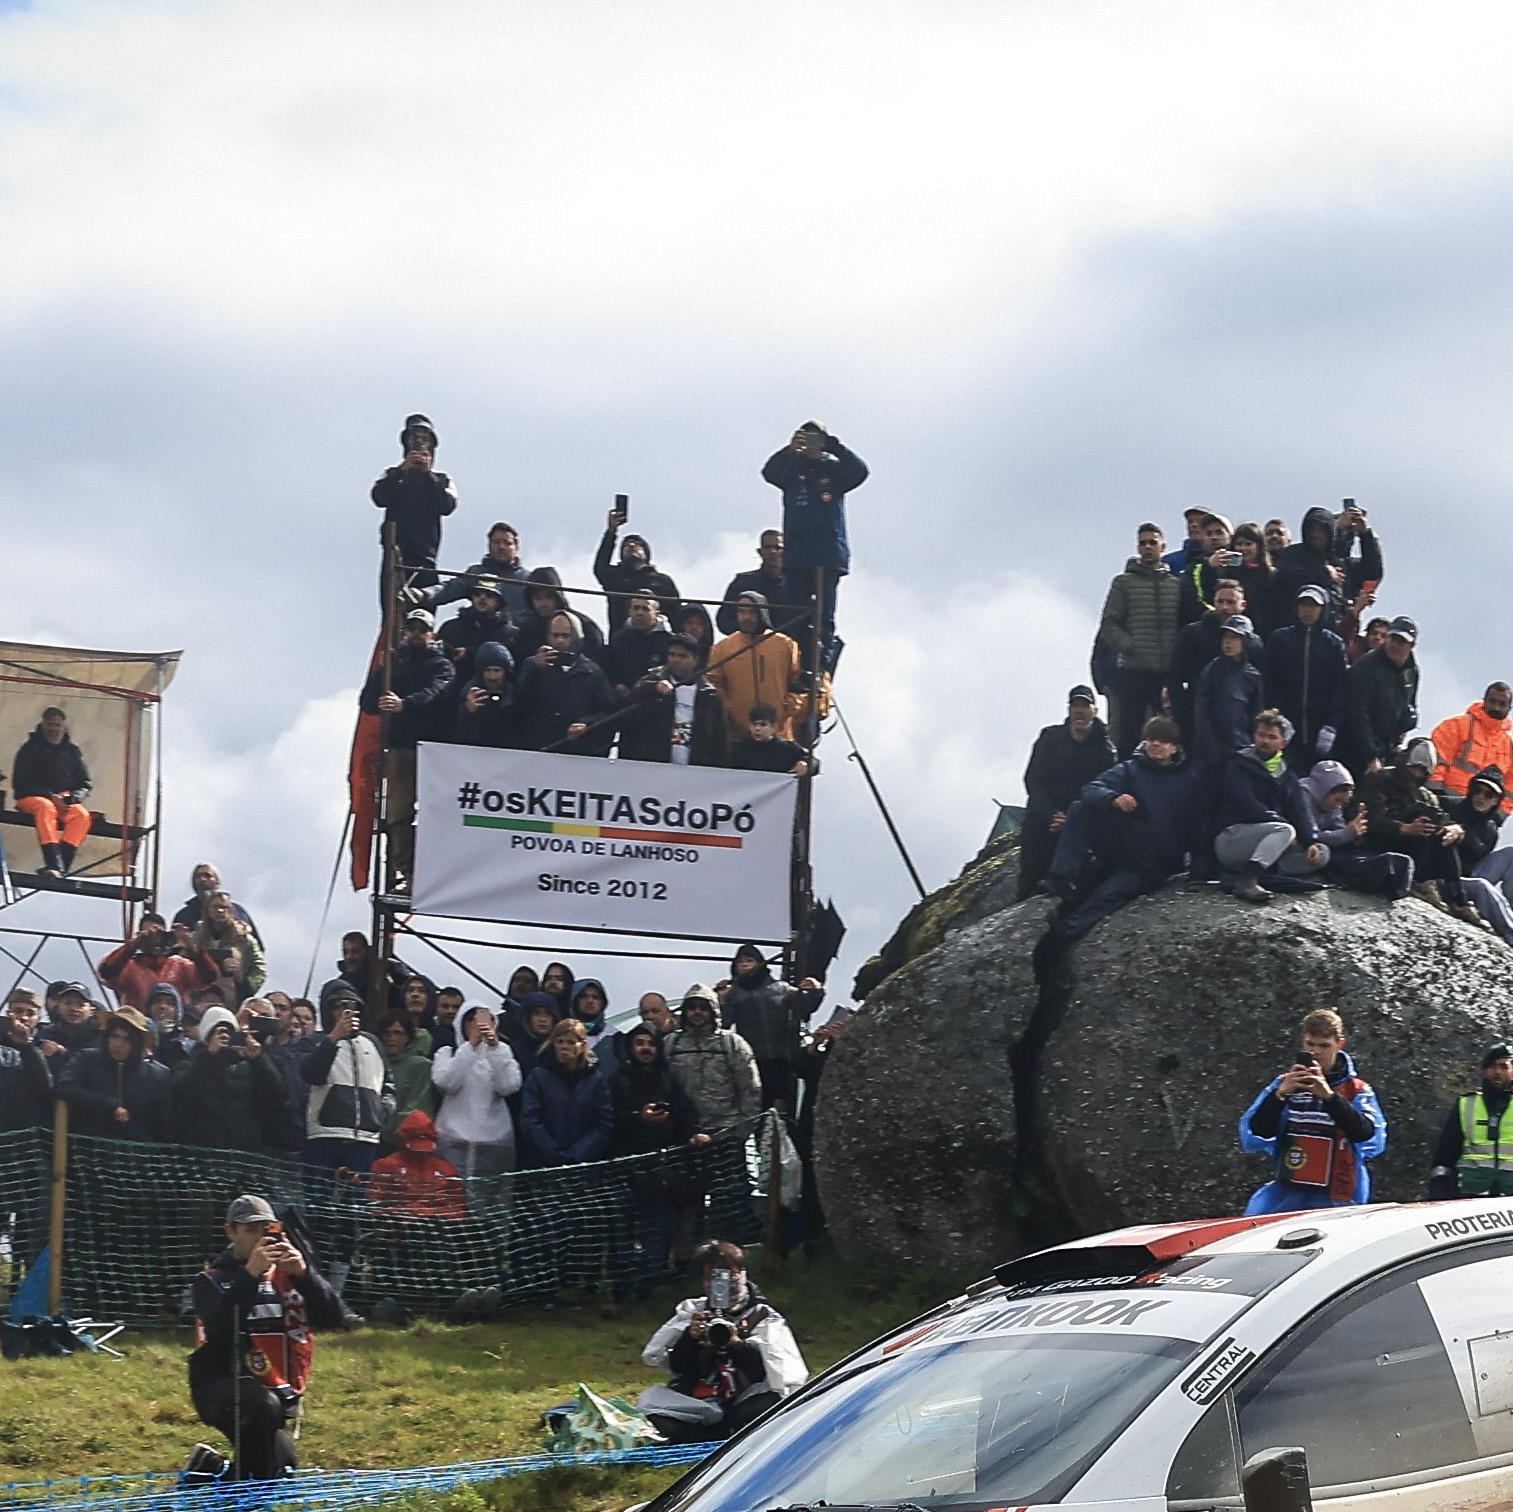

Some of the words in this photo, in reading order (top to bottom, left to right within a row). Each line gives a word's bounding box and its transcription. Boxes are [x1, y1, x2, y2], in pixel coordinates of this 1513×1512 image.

[457, 781, 756, 834] #osKEITASdoPó
[510, 835, 576, 855] POVOA
[581, 840, 606, 857] DE
[610, 843, 699, 864] LANHOSO
[538, 872, 600, 897] Since
[607, 878, 668, 901] 2012
